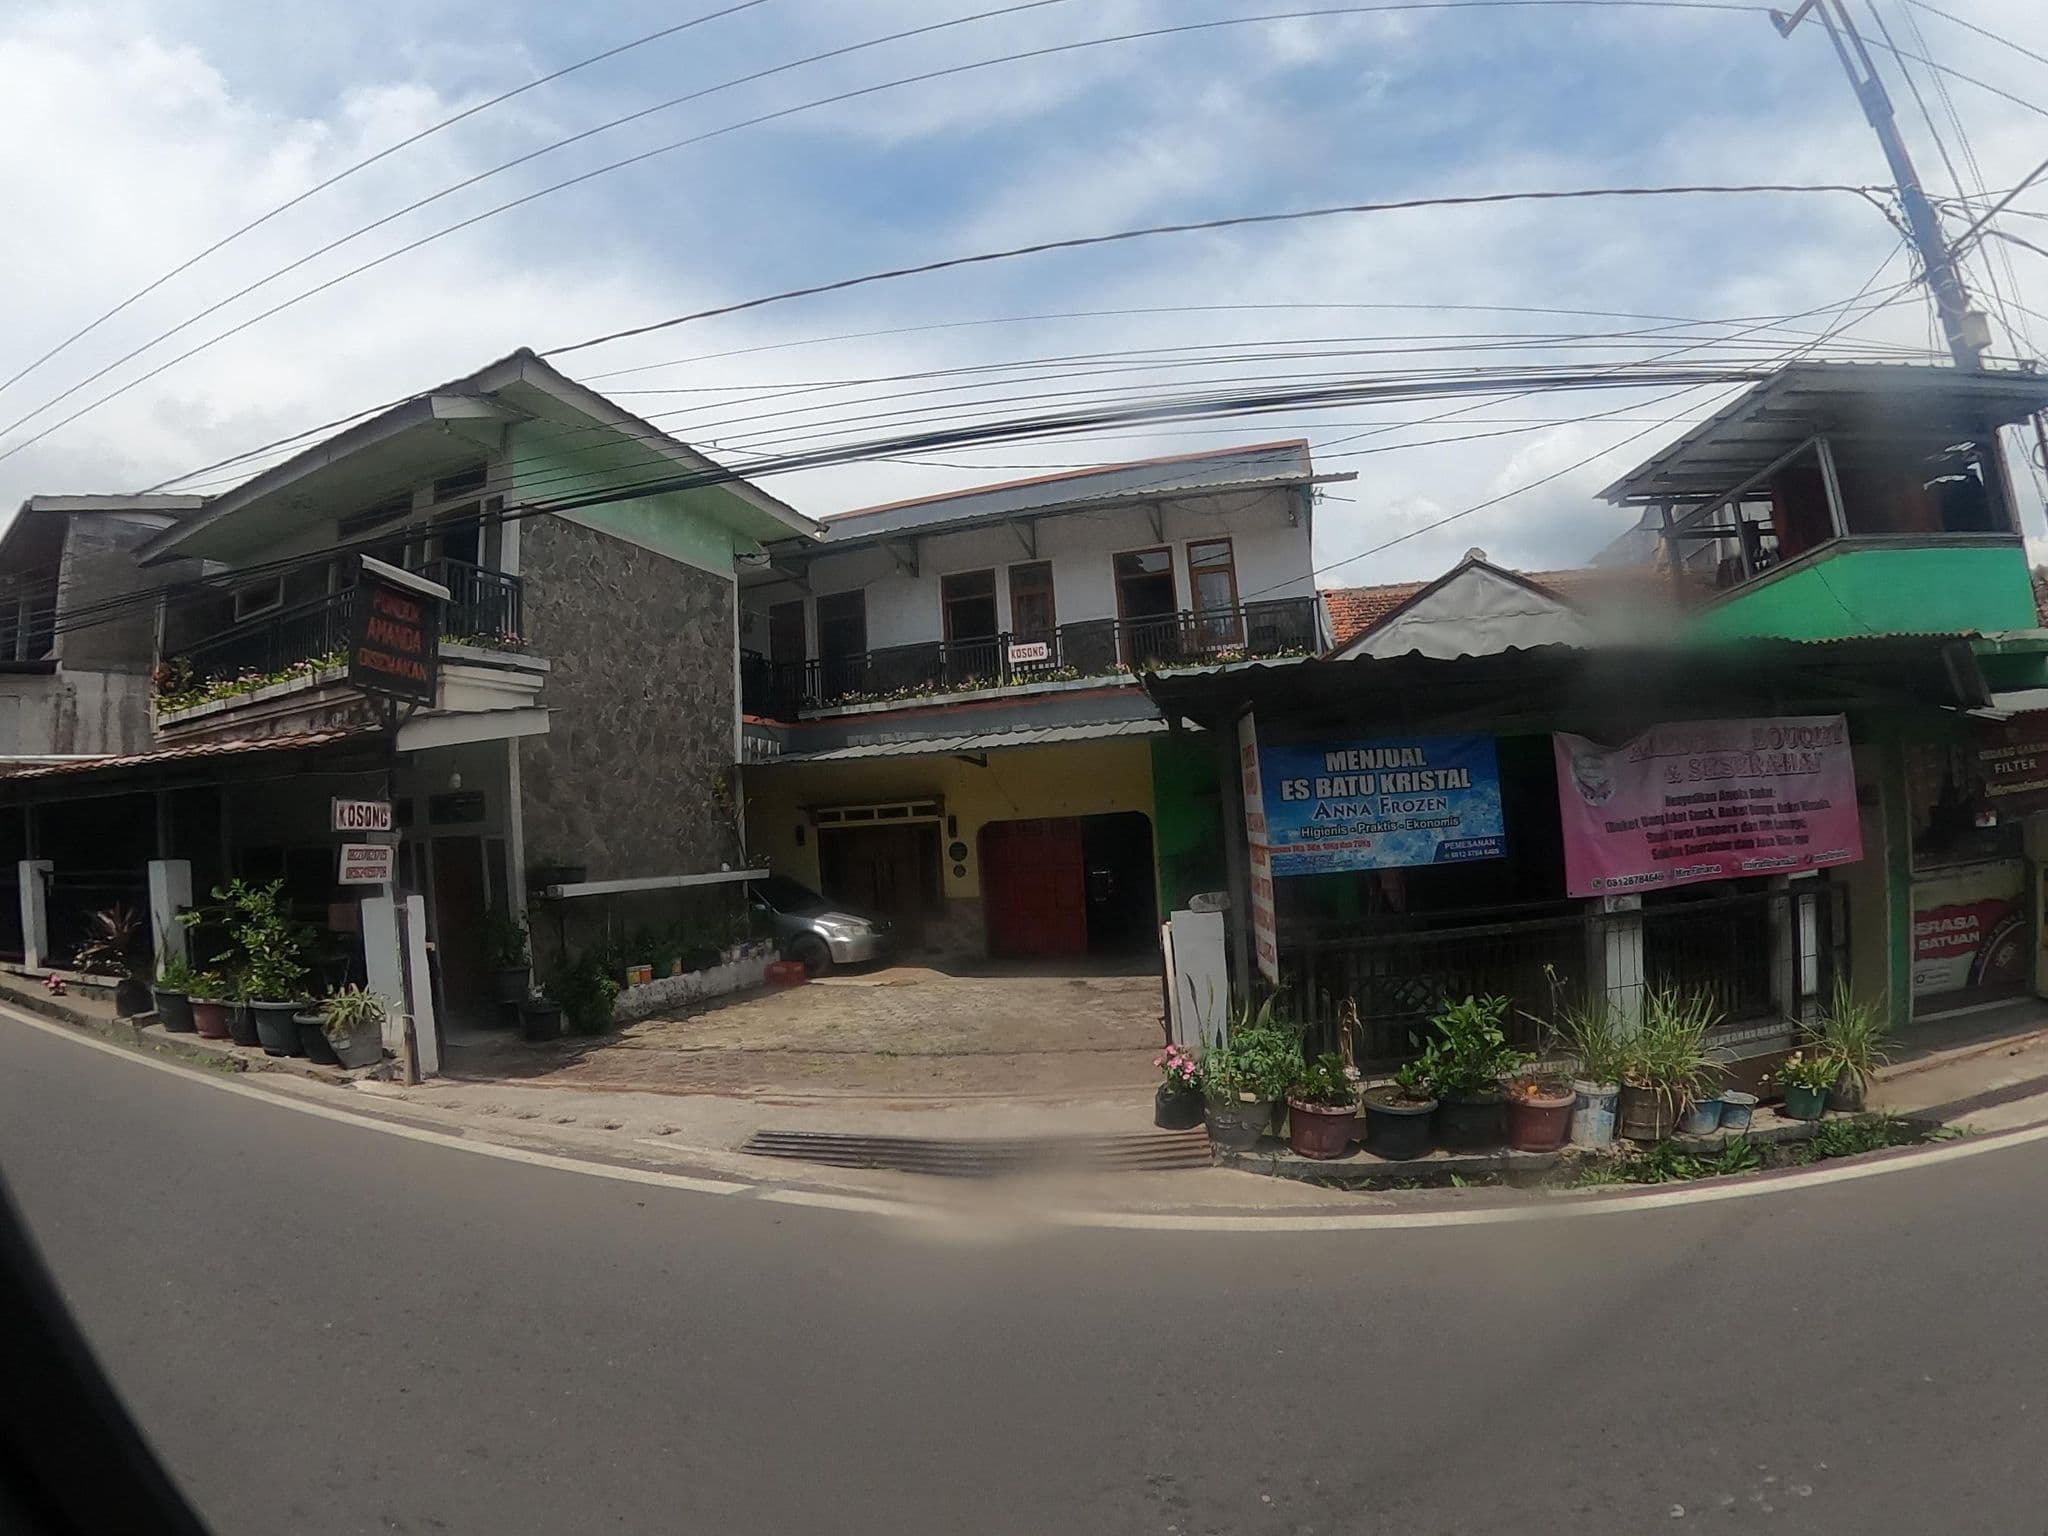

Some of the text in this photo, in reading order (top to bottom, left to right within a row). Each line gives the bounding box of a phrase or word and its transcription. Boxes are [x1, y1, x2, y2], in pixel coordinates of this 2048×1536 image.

[367, 616, 422, 653] AMANDA
[1011, 646, 1044, 659] KOSONG
[1326, 747, 1427, 772] MENJUAL
[1994, 759, 2038, 775] FILTER
[1281, 768, 1471, 801] ES BATU KRISTAL
[339, 804, 388, 828] KOSONG
[1358, 821, 1397, 834] Praktis
[1406, 814, 1460, 831] Ekonomis
[1919, 930, 1980, 950] SATUAN
